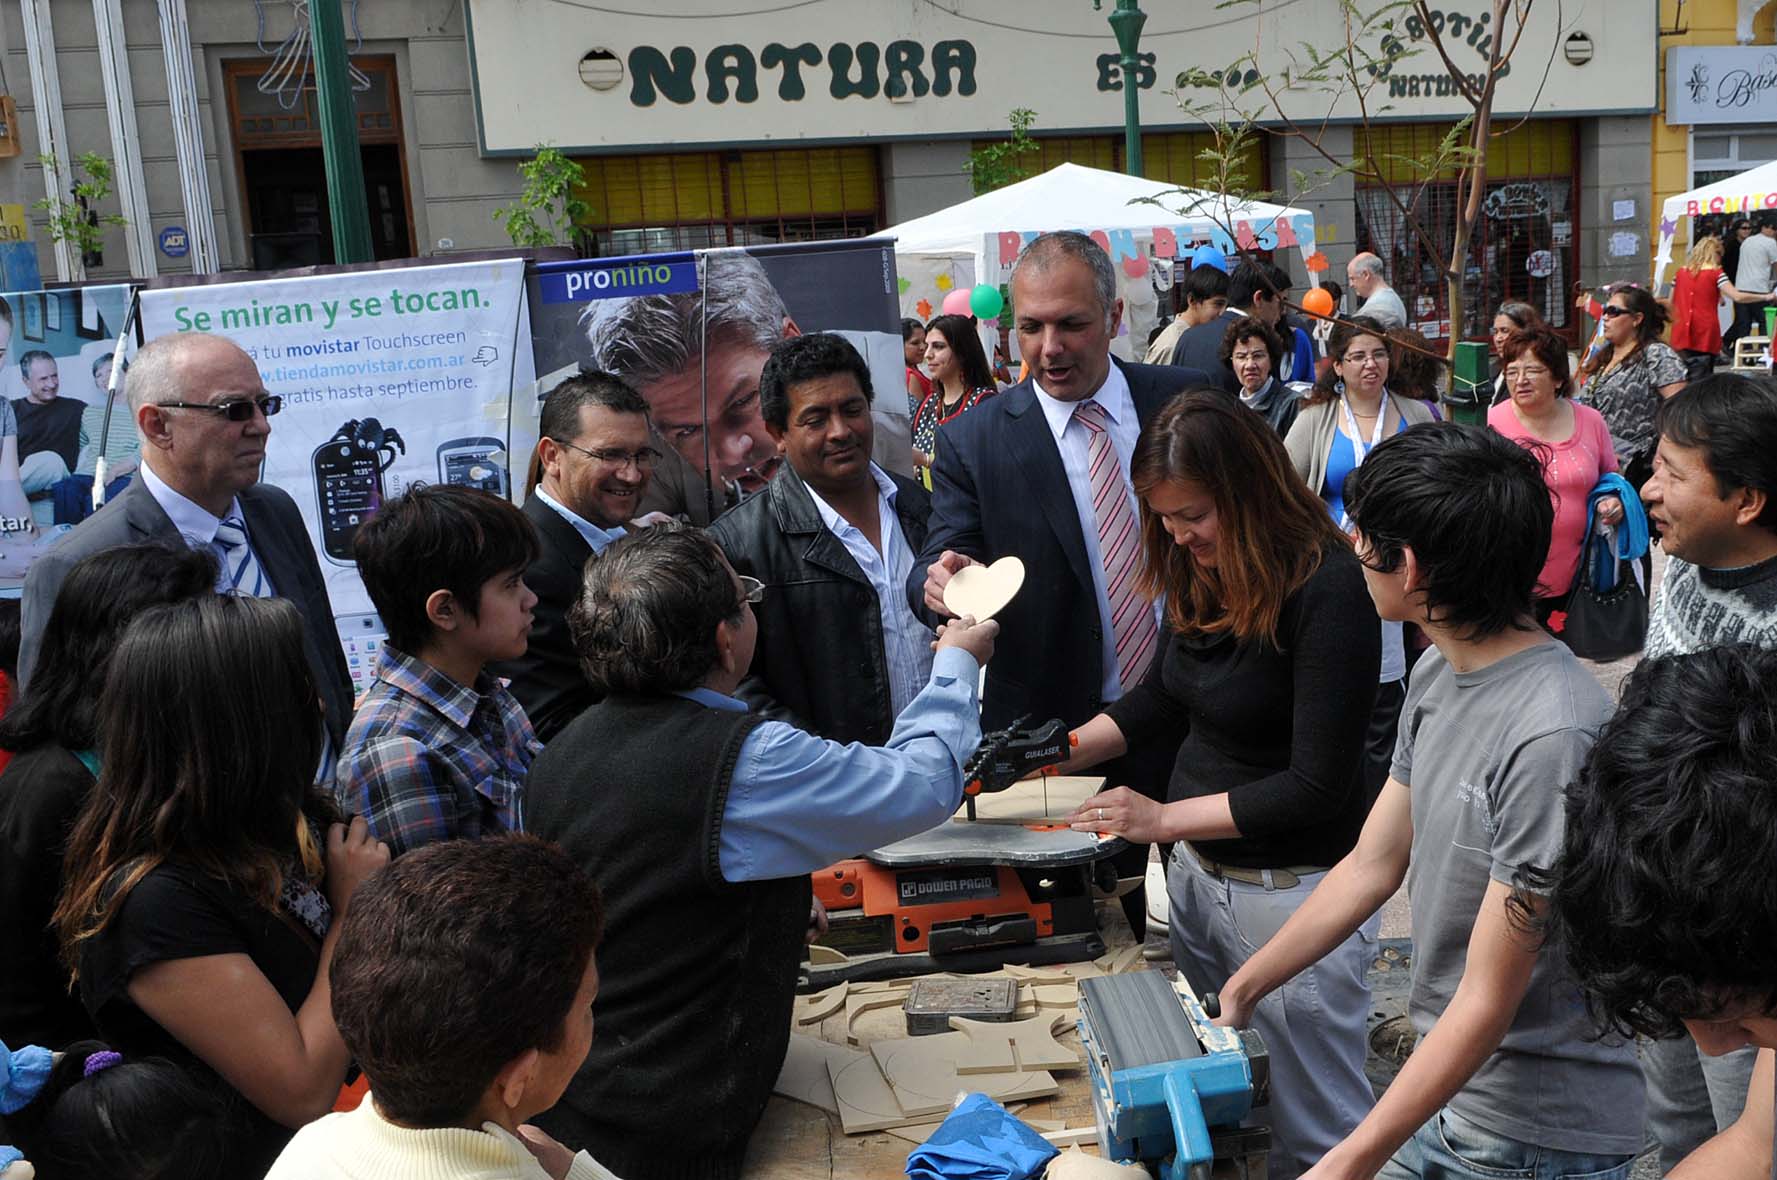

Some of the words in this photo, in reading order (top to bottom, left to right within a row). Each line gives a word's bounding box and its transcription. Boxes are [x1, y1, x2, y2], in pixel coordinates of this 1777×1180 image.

[628, 40, 977, 107] NATURA
[164, 235, 185, 248] ADT
[565, 262, 672, 299] proniño
[174, 306, 211, 332] Se
[221, 299, 313, 329] miran
[321, 300, 339, 329] y
[350, 296, 381, 318] se
[390, 288, 490, 315] tocan.
[264, 345, 281, 359] tu
[287, 339, 360, 357] movistar
[363, 331, 466, 351] Touchscreen
[328, 384, 373, 401] hasta
[378, 376, 478, 399] septiembre.
[918, 880, 957, 894] DOWEN
